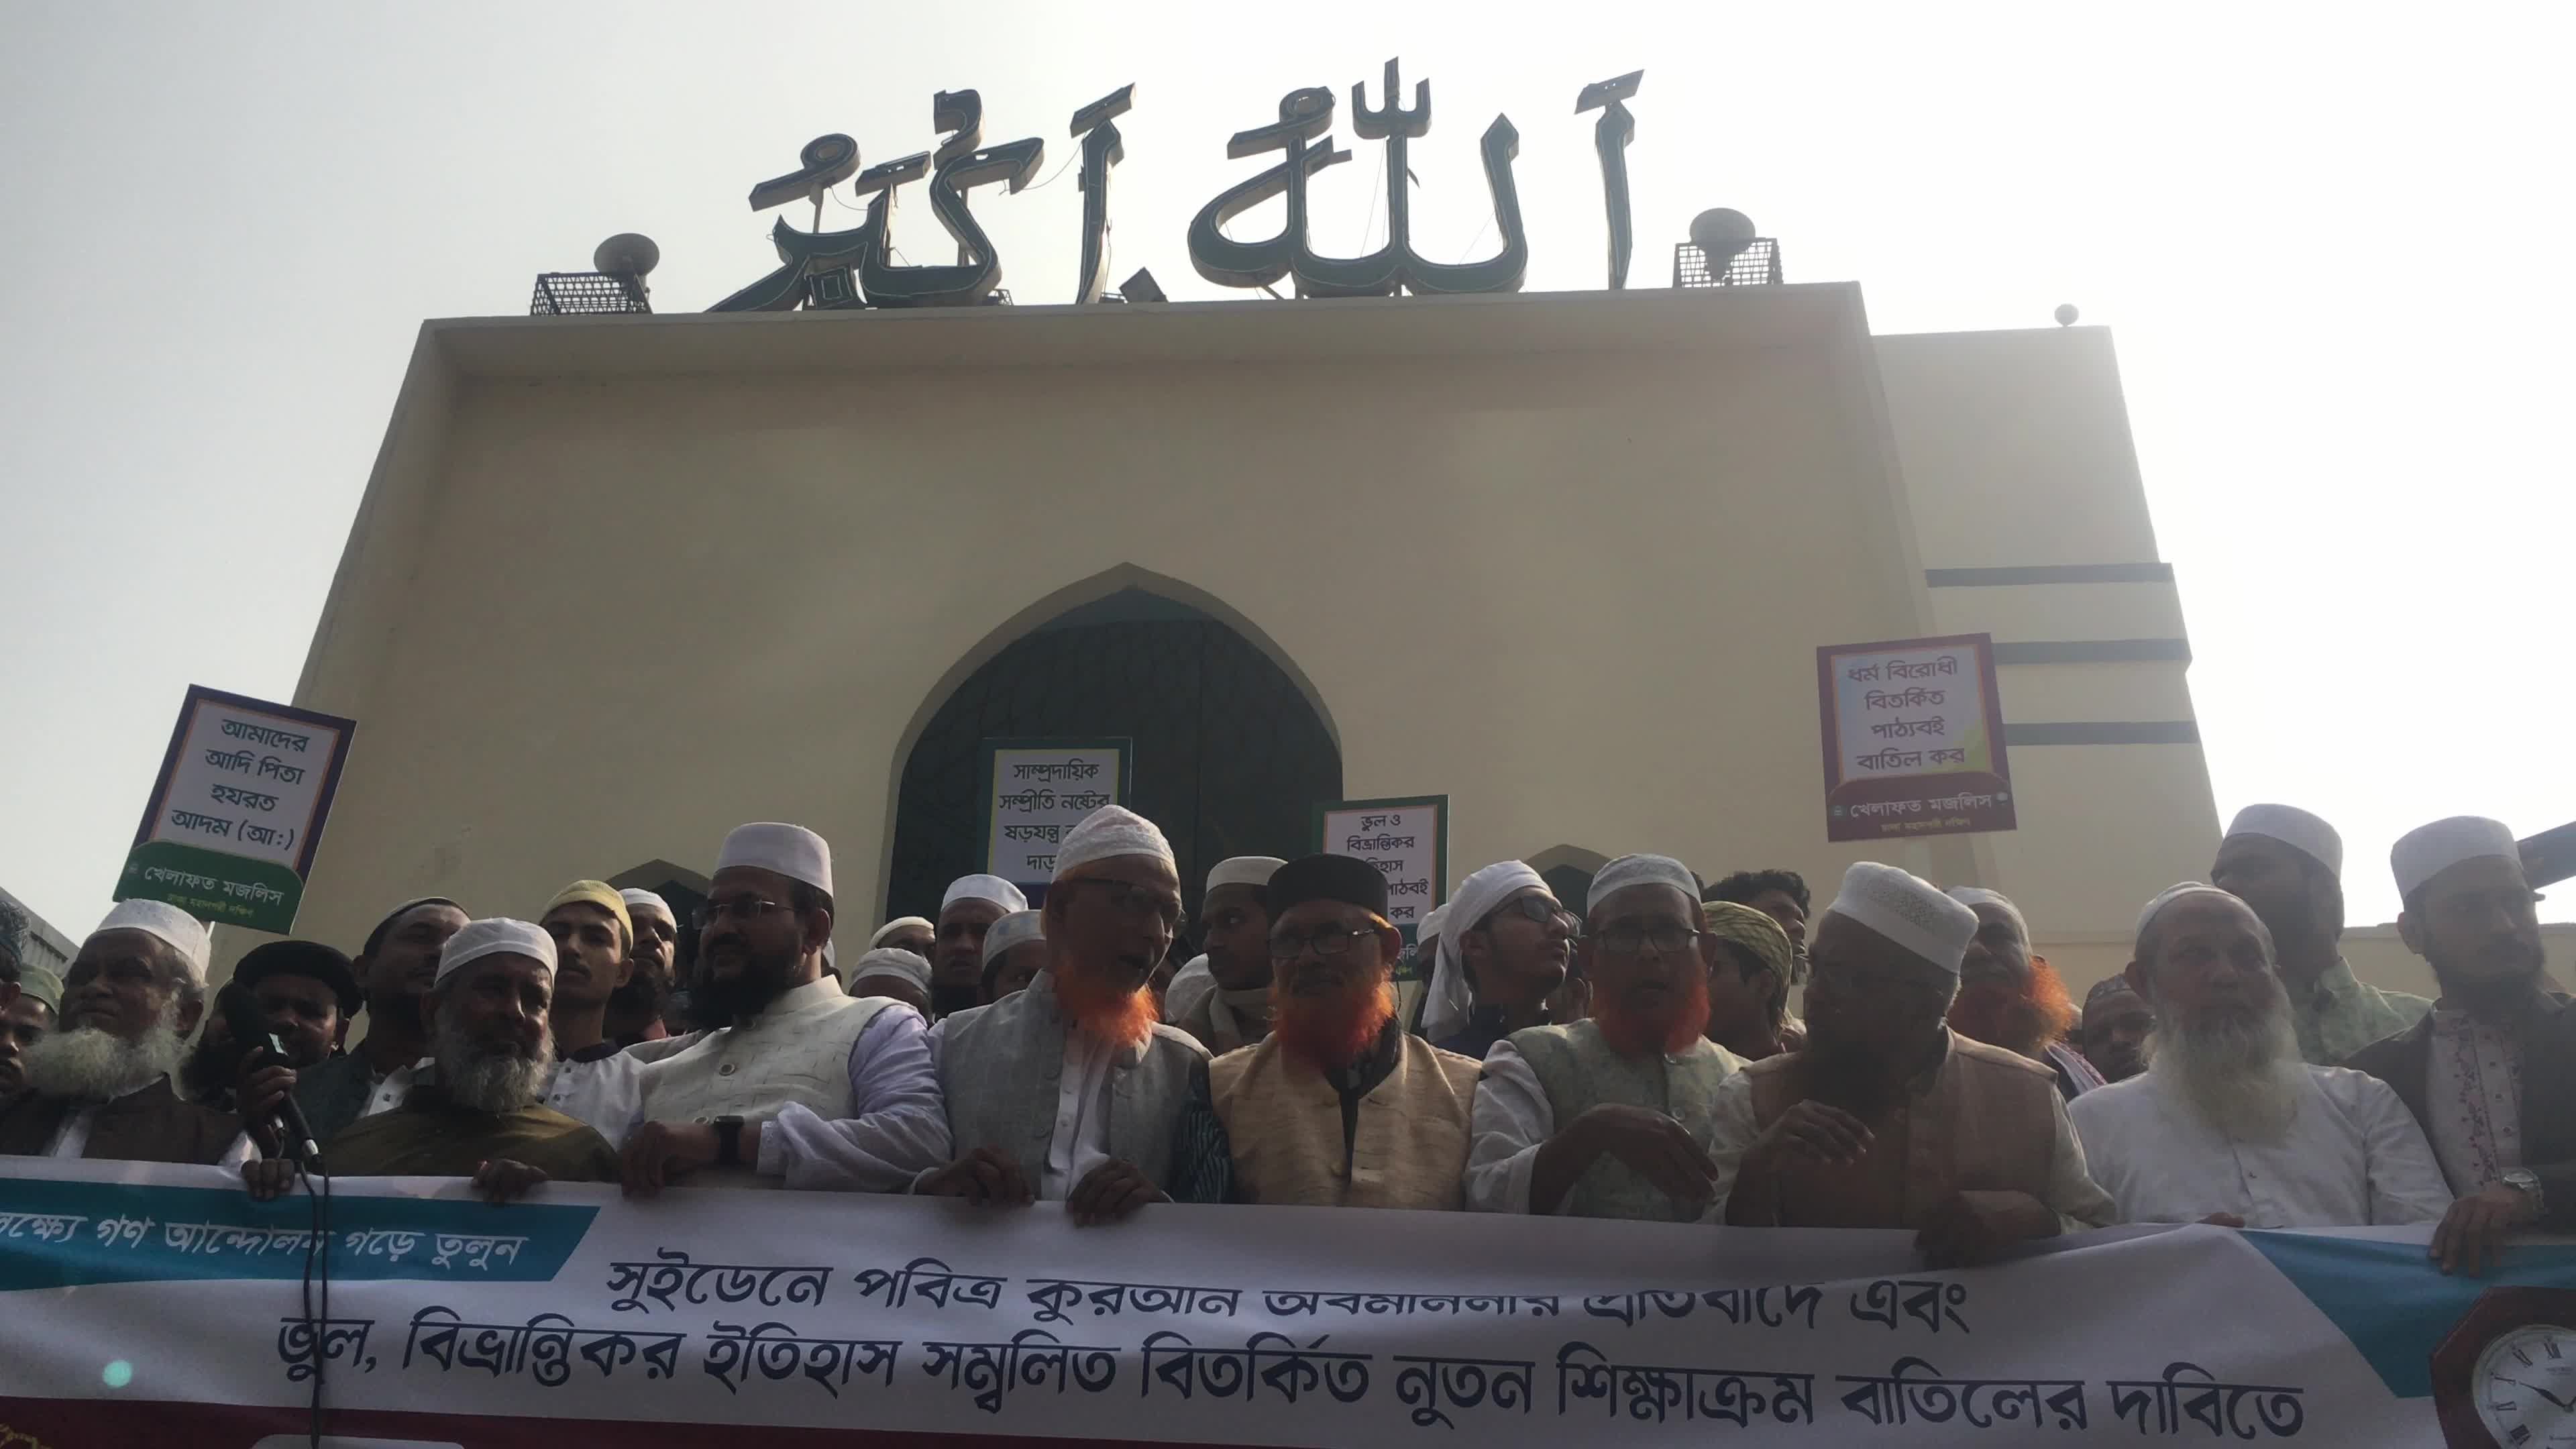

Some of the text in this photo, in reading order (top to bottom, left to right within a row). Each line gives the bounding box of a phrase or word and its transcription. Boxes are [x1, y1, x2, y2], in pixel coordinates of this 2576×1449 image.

[1847, 655, 1957, 682] ধর্ম বিরোধী
[1864, 687, 1945, 710] বিতর্কিত
[221, 719, 309, 753] আমাদের
[1871, 716, 1945, 739] পাঠ্যবই
[205, 749, 305, 785] আদি পিতা
[1856, 747, 1964, 770] বাতিল কর
[211, 784, 279, 812] হযরত
[999, 788, 1056, 813] সম্প্রীতি
[1850, 792, 1992, 818] খেলাফত মজলিস
[172, 810, 233, 837] আদম
[1361, 814, 1401, 831] ভুল ও
[1347, 833, 1415, 851] বিভ্রান্তিকর
[144, 866, 284, 906] খেলাফত মজলিস
[1390, 906, 1415, 919] কর
[97, 1214, 155, 1248] গণ
[345, 1228, 426, 1262] গড়ে
[431, 1232, 529, 1271] তুলুন
[606, 1247, 833, 1313] সুইডেনে
[855, 1256, 1008, 1309] পবিত্র
[1026, 1279, 1243, 1325] কুরআন
[1850, 1280, 1970, 1334] এবং
[278, 1305, 2304, 1438] ভুল, বিভ্রান্তিকর ইতিহাস সম্বলিত বিতর্কিত নুতন শিক্ষাক্রম বাতিলের দাবিতে
